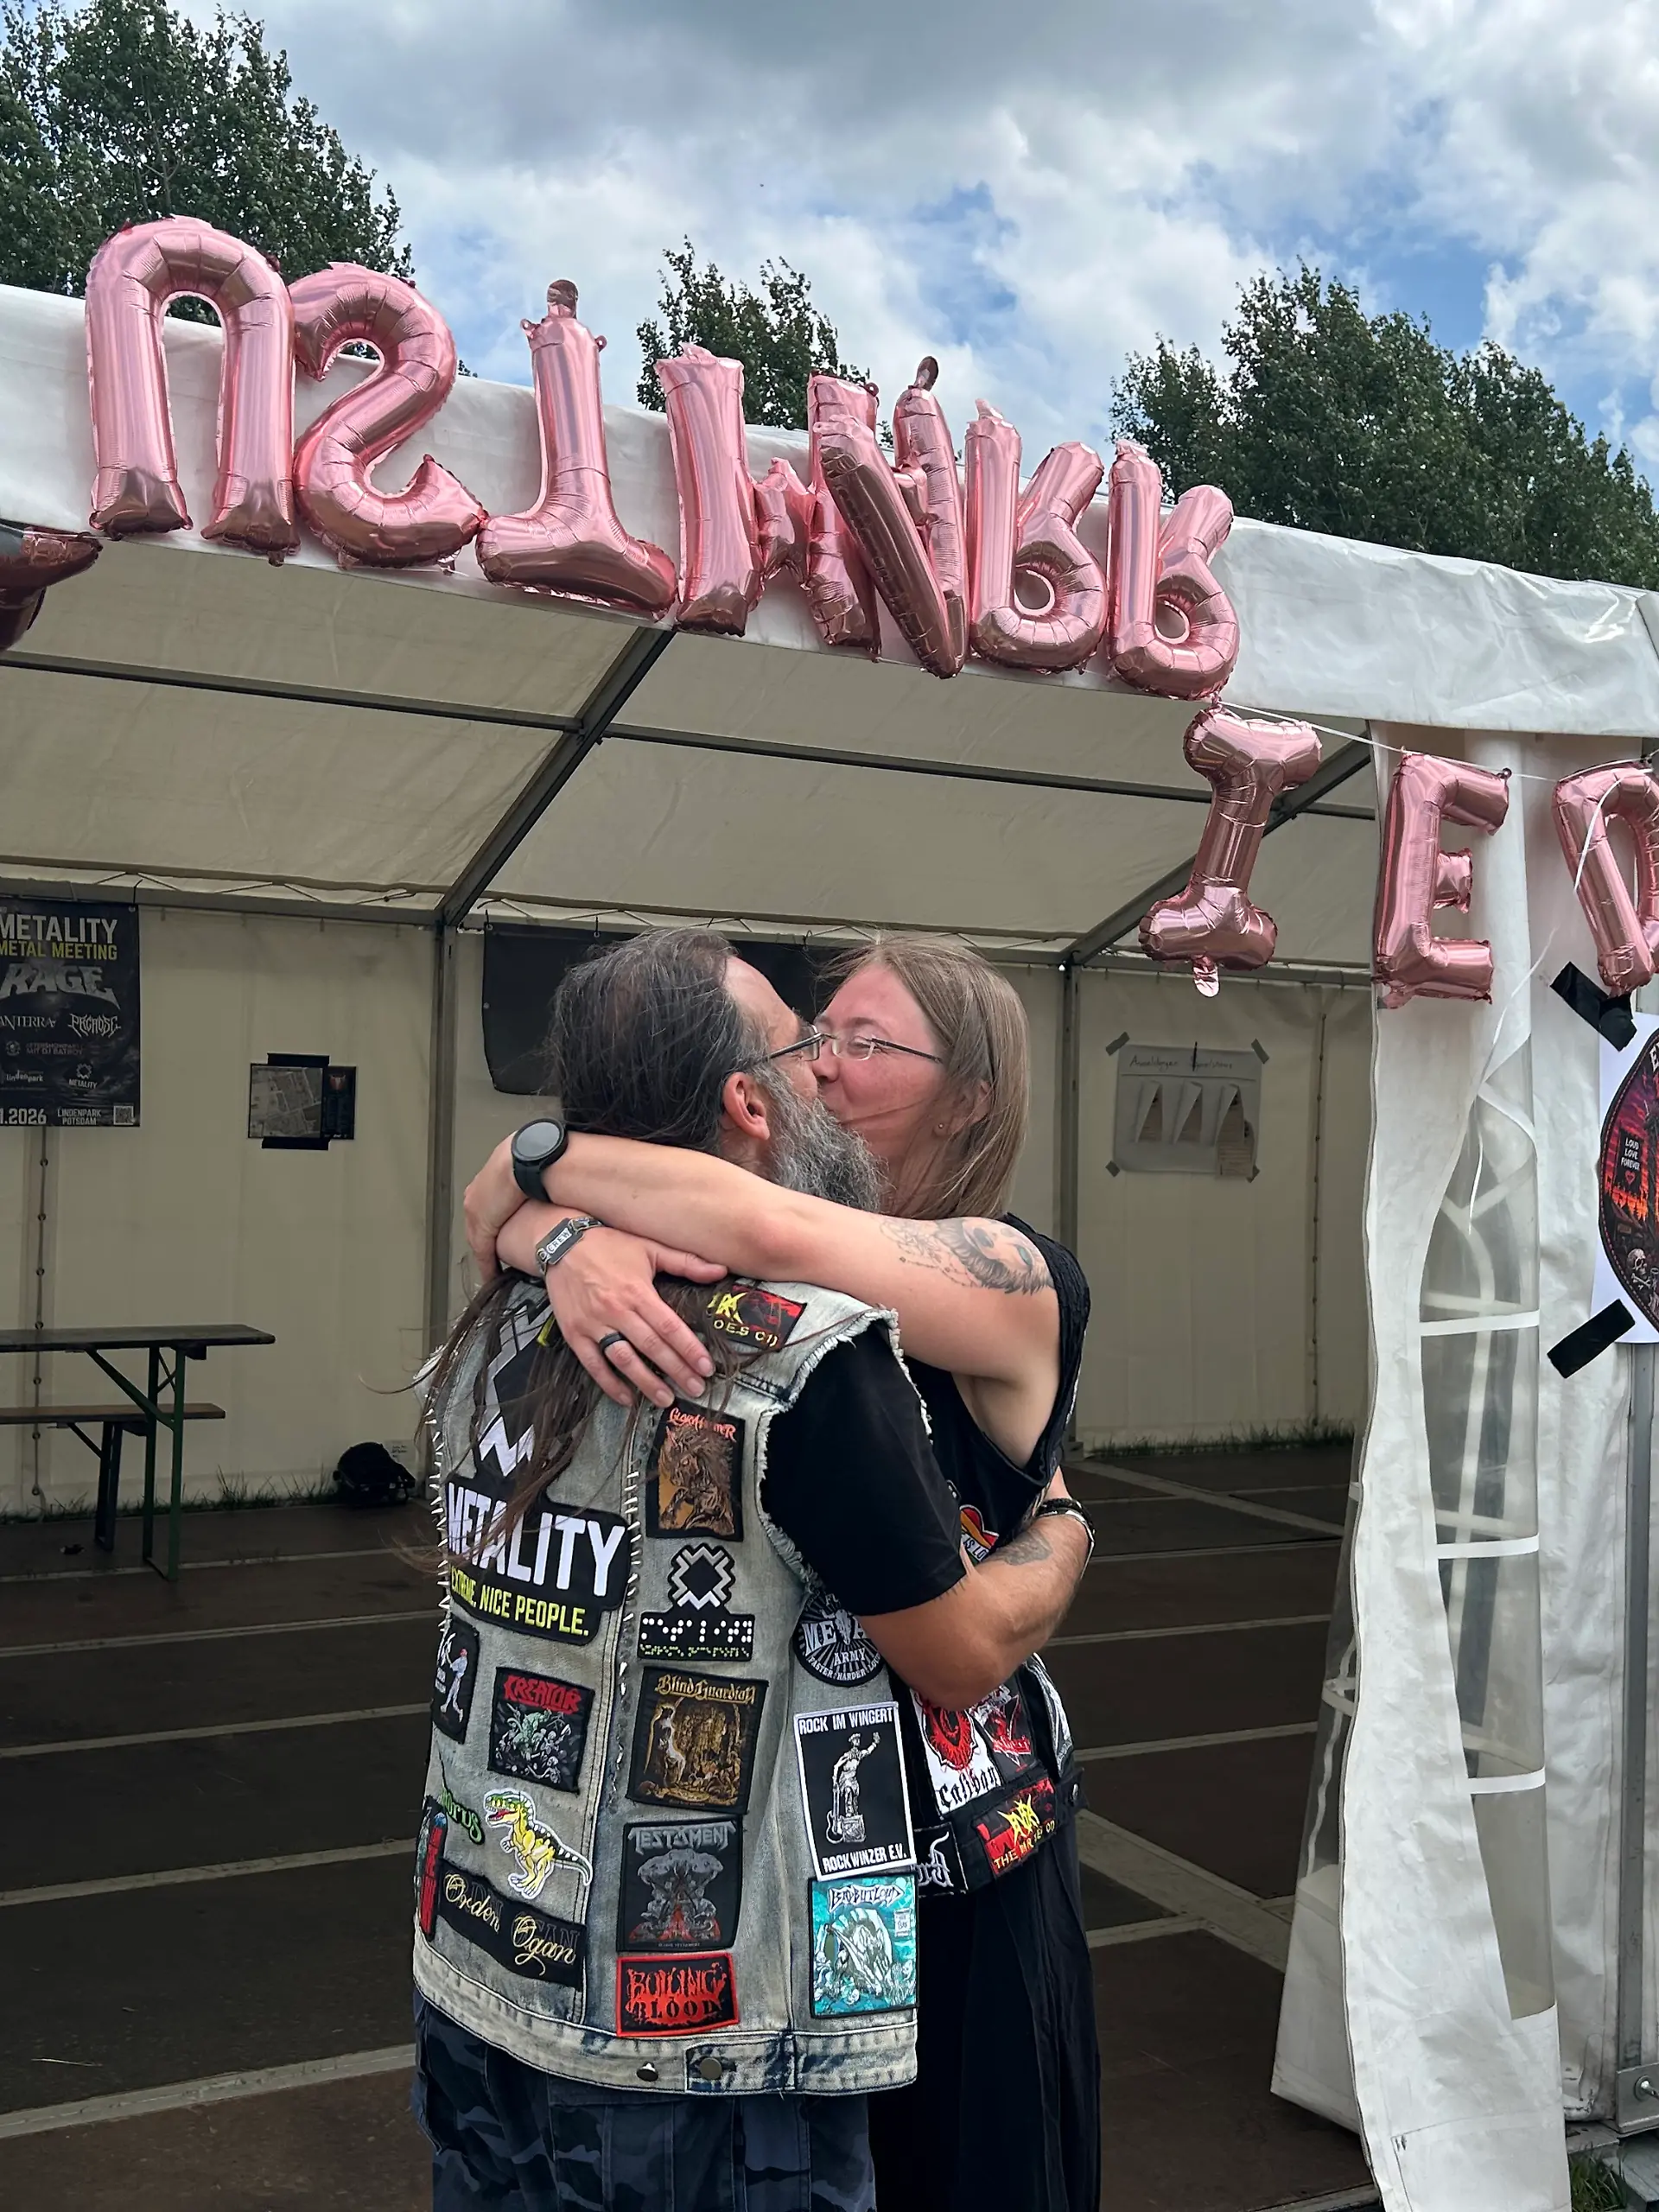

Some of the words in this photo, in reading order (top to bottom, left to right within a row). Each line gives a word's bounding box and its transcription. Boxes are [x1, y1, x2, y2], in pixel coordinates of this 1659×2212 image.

[0, 914, 118, 944] METALITY
[0, 940, 47, 957] METAL
[52, 943, 118, 961] MEETING
[0, 963, 121, 1010] RAGE
[6, 1070, 43, 1083] lindenpark
[68, 1078, 98, 1090] METALITY
[57, 1108, 102, 1118] LINDENPARK
[1624, 1137, 1640, 1151] LOUD
[1624, 1147, 1638, 1160] LOVE
[1620, 1157, 1641, 1171] FOREVER
[448, 1482, 626, 1597] METALITY
[479, 1585, 512, 1618] NICE
[515, 1595, 589, 1637] PEOPLE.
[808, 1656, 834, 1678] FASTER
[836, 1669, 867, 1681] HARDER
[834, 1647, 867, 1667] ARMY
[504, 1675, 582, 1715] KREATOR
[654, 1674, 696, 1698] Blind
[695, 1679, 756, 1705] Guardian
[798, 1717, 829, 1735] ROCK
[832, 1715, 847, 1731] IM
[848, 1707, 894, 1728] WINGERT
[627, 1821, 736, 1856] TESTAMENT
[887, 1843, 907, 1860] E.V.
[512, 1915, 578, 1976] Ogan
[626, 1961, 728, 1998] BOILING
